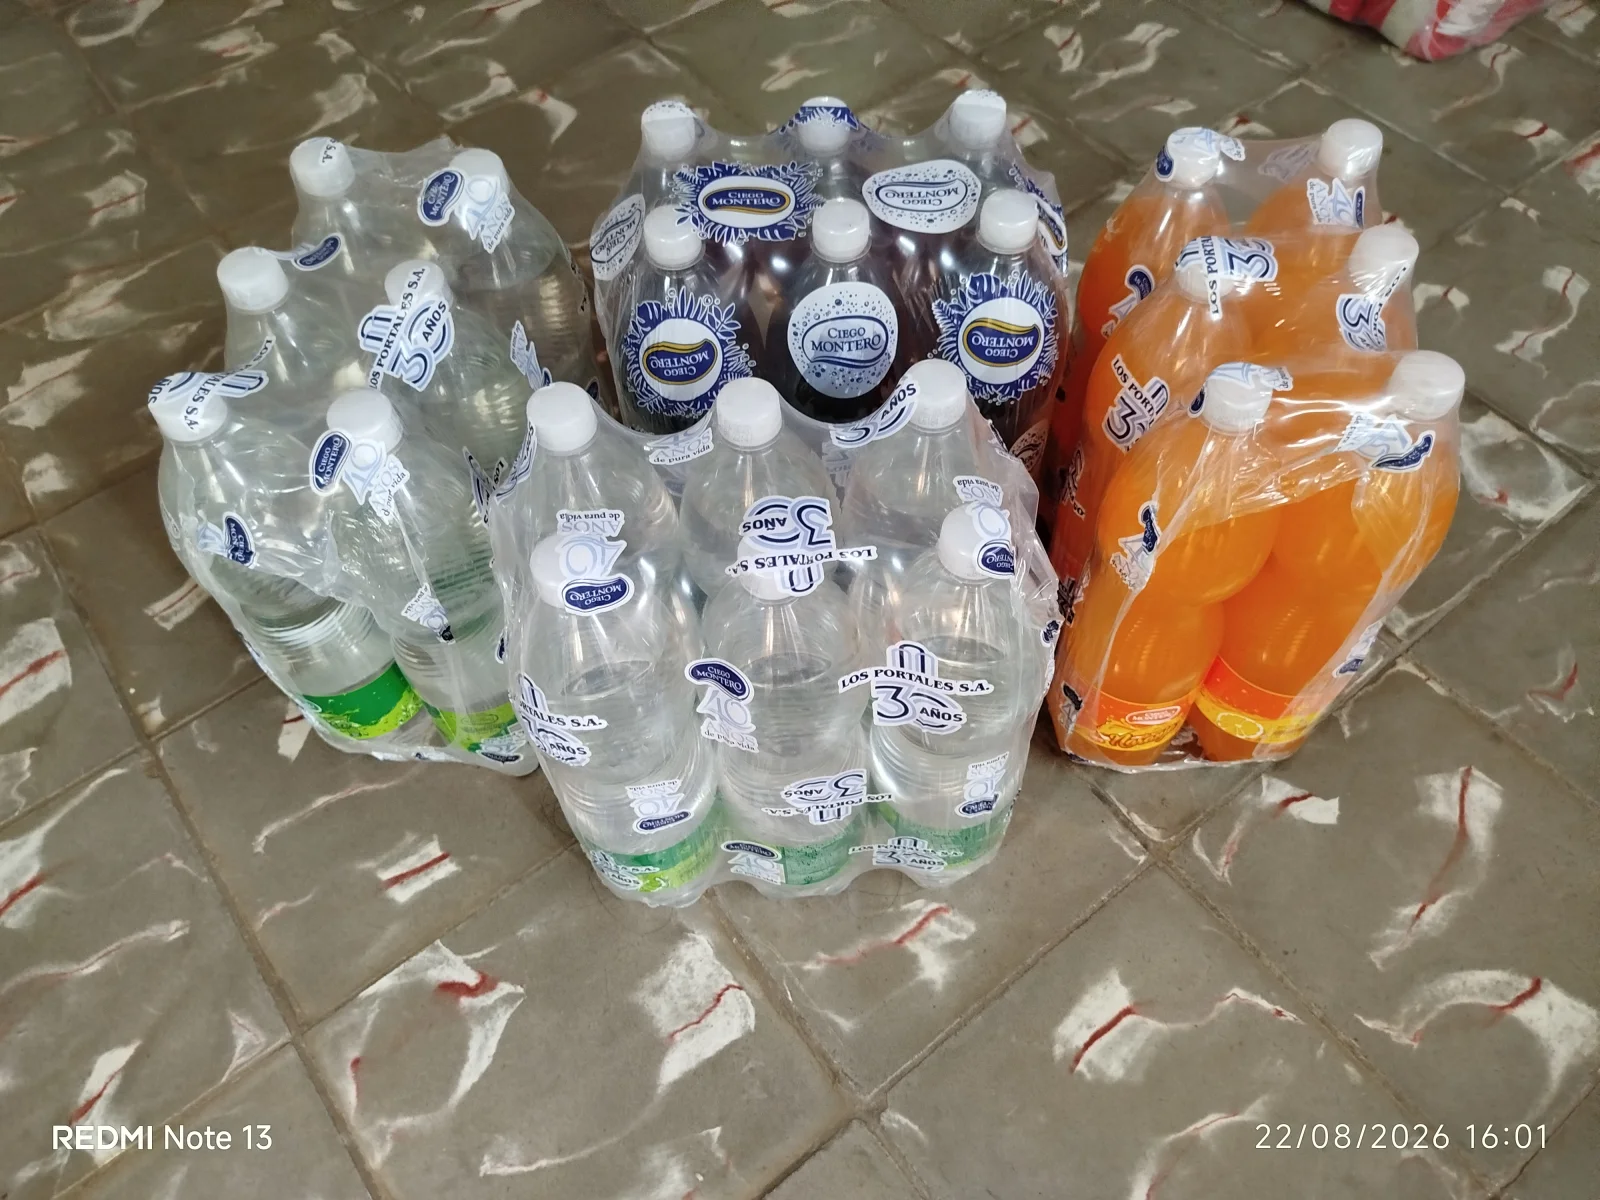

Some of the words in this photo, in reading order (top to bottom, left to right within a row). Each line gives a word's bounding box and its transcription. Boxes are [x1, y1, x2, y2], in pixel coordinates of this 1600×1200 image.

[430, 174, 457, 217] MONTERO
[712, 197, 782, 206] MONTERO
[728, 191, 765, 199] CIEGO
[885, 188, 960, 200] MONTERO
[902, 198, 943, 206] CIEGO
[486, 240, 495, 251] de
[494, 219, 506, 240] pura
[501, 206, 514, 221] vida
[1208, 280, 1220, 315] LOS
[369, 370, 381, 390] LOS
[377, 292, 414, 369] PORTALES
[407, 267, 426, 289] S.A.
[421, 301, 448, 343] AÑOS
[827, 326, 866, 338] CIEGO
[811, 334, 881, 353] MONTERO
[971, 331, 1035, 349] MONTERO
[650, 350, 711, 368] MONTERO
[984, 346, 1020, 358] CIEGO
[664, 365, 698, 378] CIEGO
[1113, 358, 1130, 384] LOS
[317, 446, 332, 474] CIEGO
[668, 453, 691, 464] pura
[692, 443, 711, 457] vida
[390, 470, 407, 490] vida
[956, 479, 975, 489] vida
[558, 512, 583, 524] vida
[584, 512, 606, 521] pura
[608, 512, 622, 522] de
[742, 516, 788, 533] AÑOS
[754, 552, 834, 569] PORTALES
[839, 548, 873, 559] LOS
[728, 559, 750, 575] S.A.
[568, 583, 623, 601] MONTERO
[584, 594, 612, 606] CIEGO
[707, 666, 731, 679] CIEGO
[696, 669, 744, 694] MONTERO
[841, 669, 870, 690] LOS
[873, 668, 955, 692] PORTALES
[958, 682, 991, 693] S.A.
[919, 706, 964, 723] AÑOS
[570, 717, 603, 728] S.A.
[704, 729, 715, 738] de
[737, 740, 755, 752] vida
[549, 741, 588, 756] AÑOS
[784, 788, 823, 798] AÑOS
[867, 793, 893, 801] LOS
[851, 844, 874, 852] LOS
[910, 858, 945, 866] AÑOS
[610, 872, 641, 886] AÑOS
